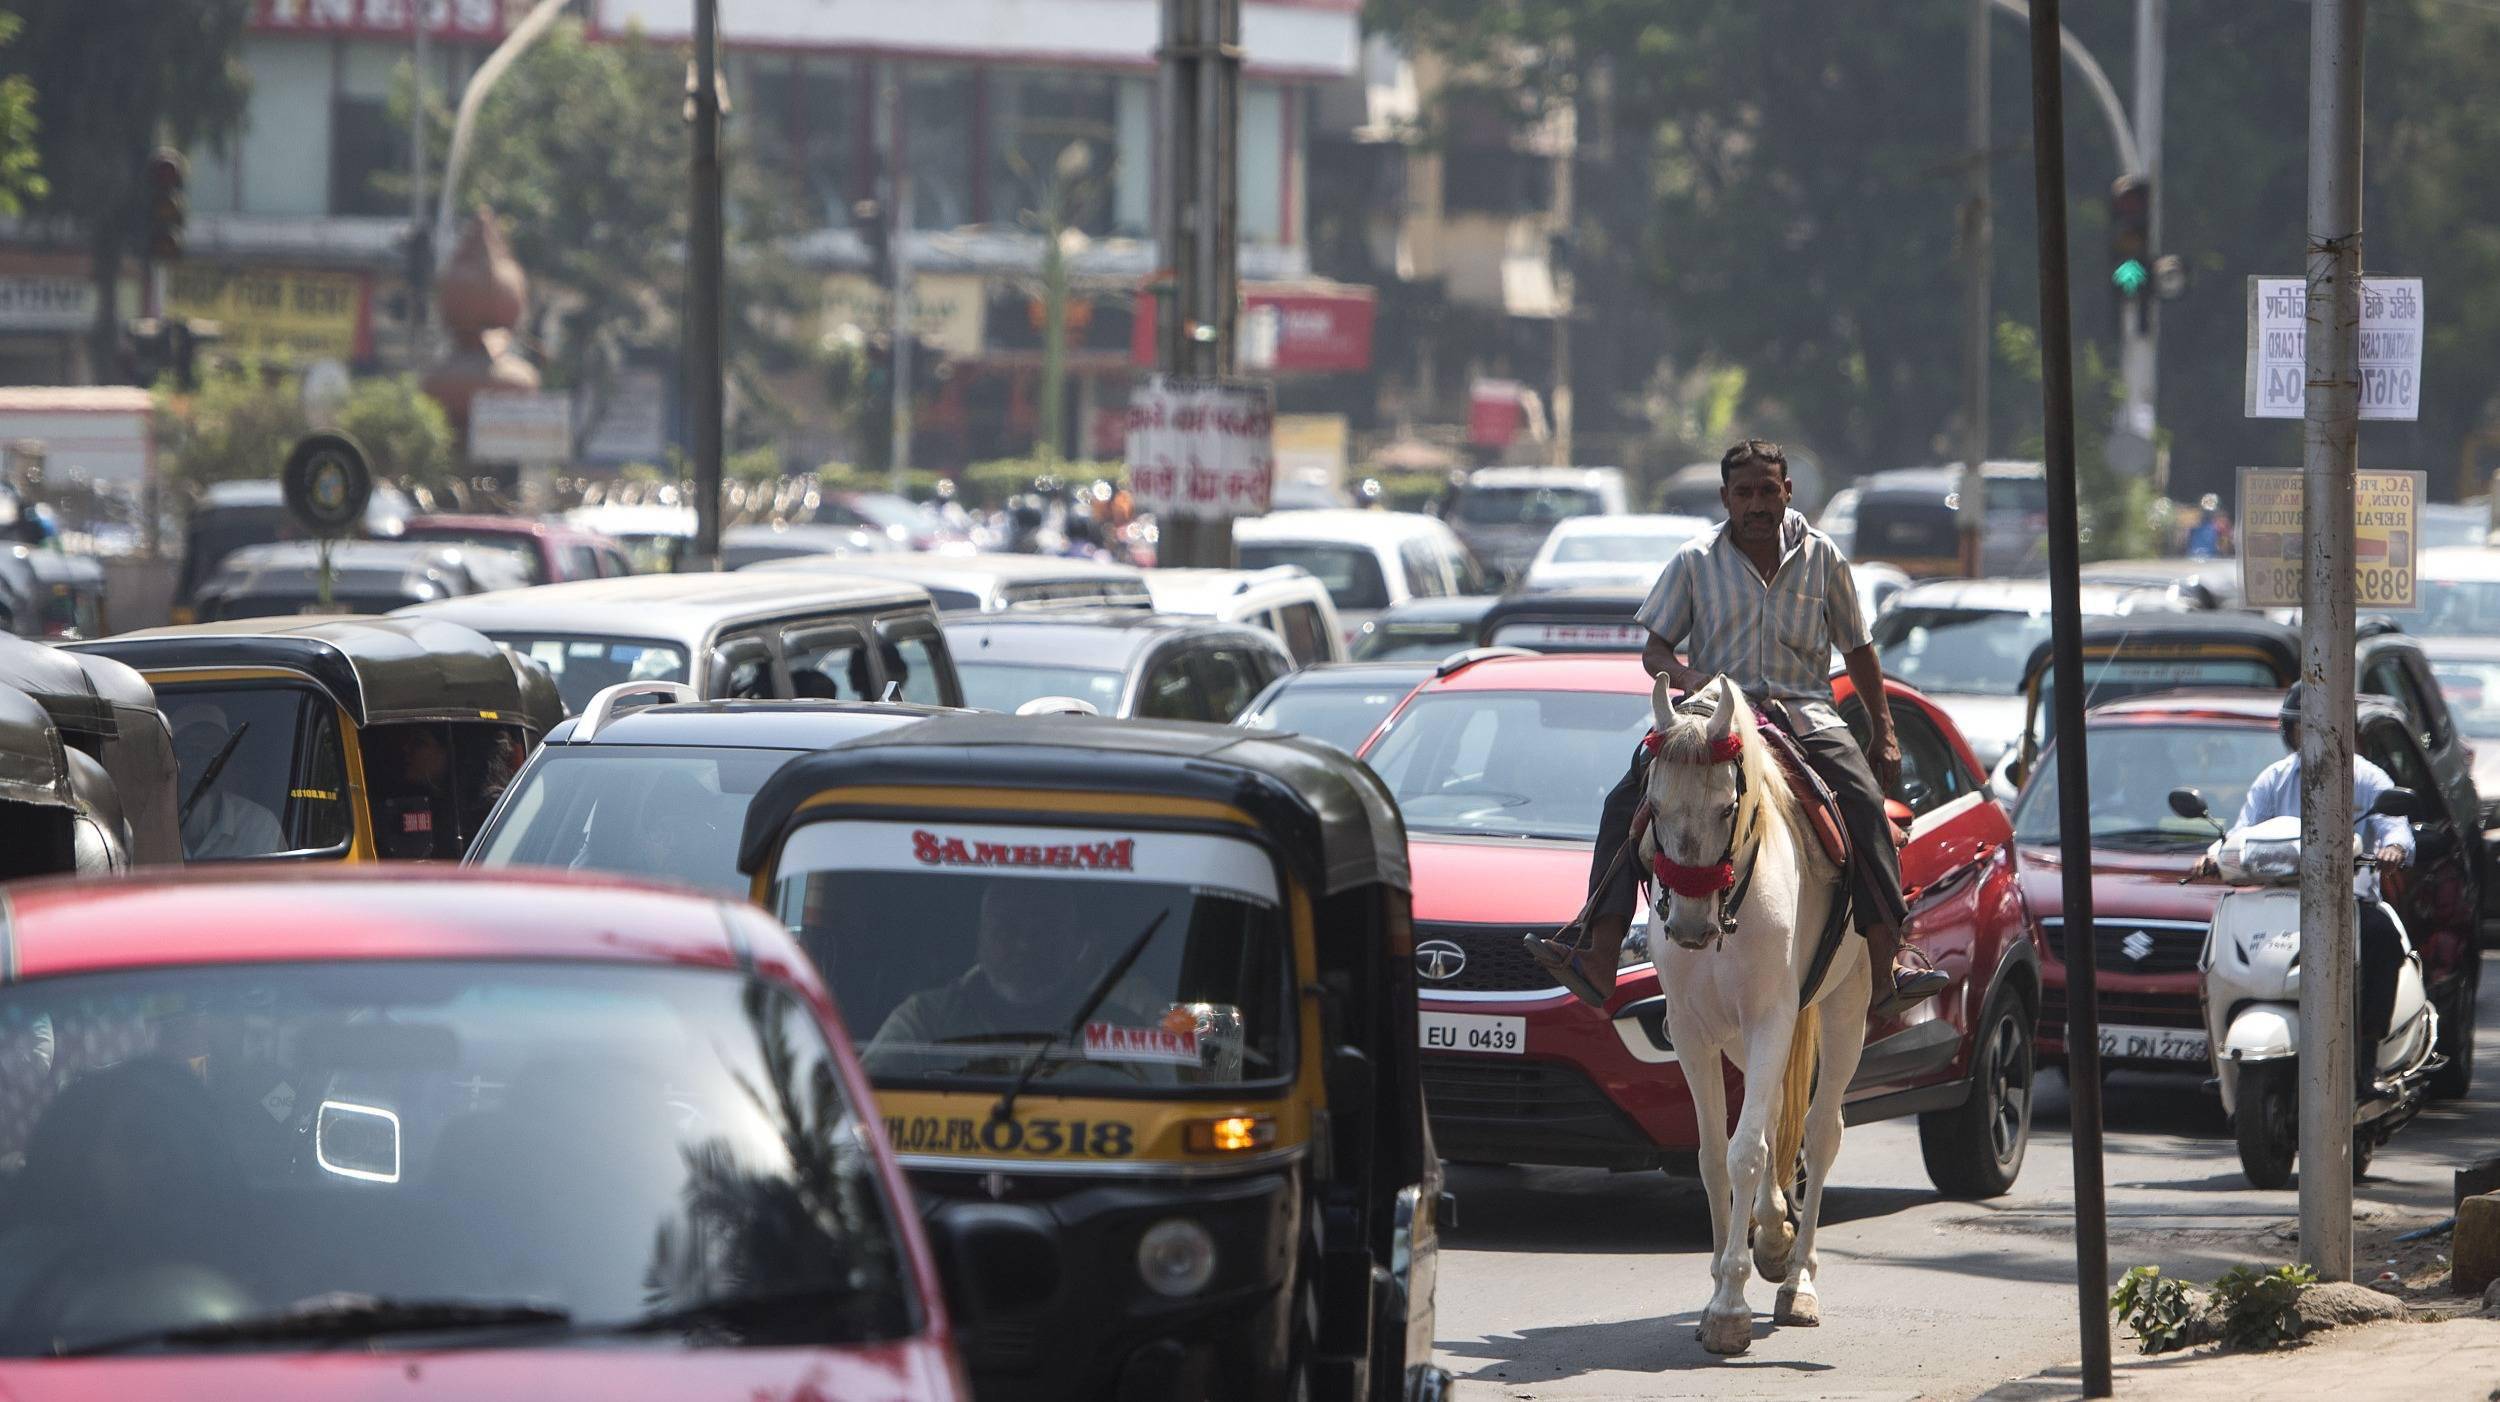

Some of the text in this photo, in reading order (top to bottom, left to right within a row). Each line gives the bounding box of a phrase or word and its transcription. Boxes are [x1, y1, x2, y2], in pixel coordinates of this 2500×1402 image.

[1428, 1026, 1517, 1050] EU 0439
[2128, 1036, 2156, 1058] DN
